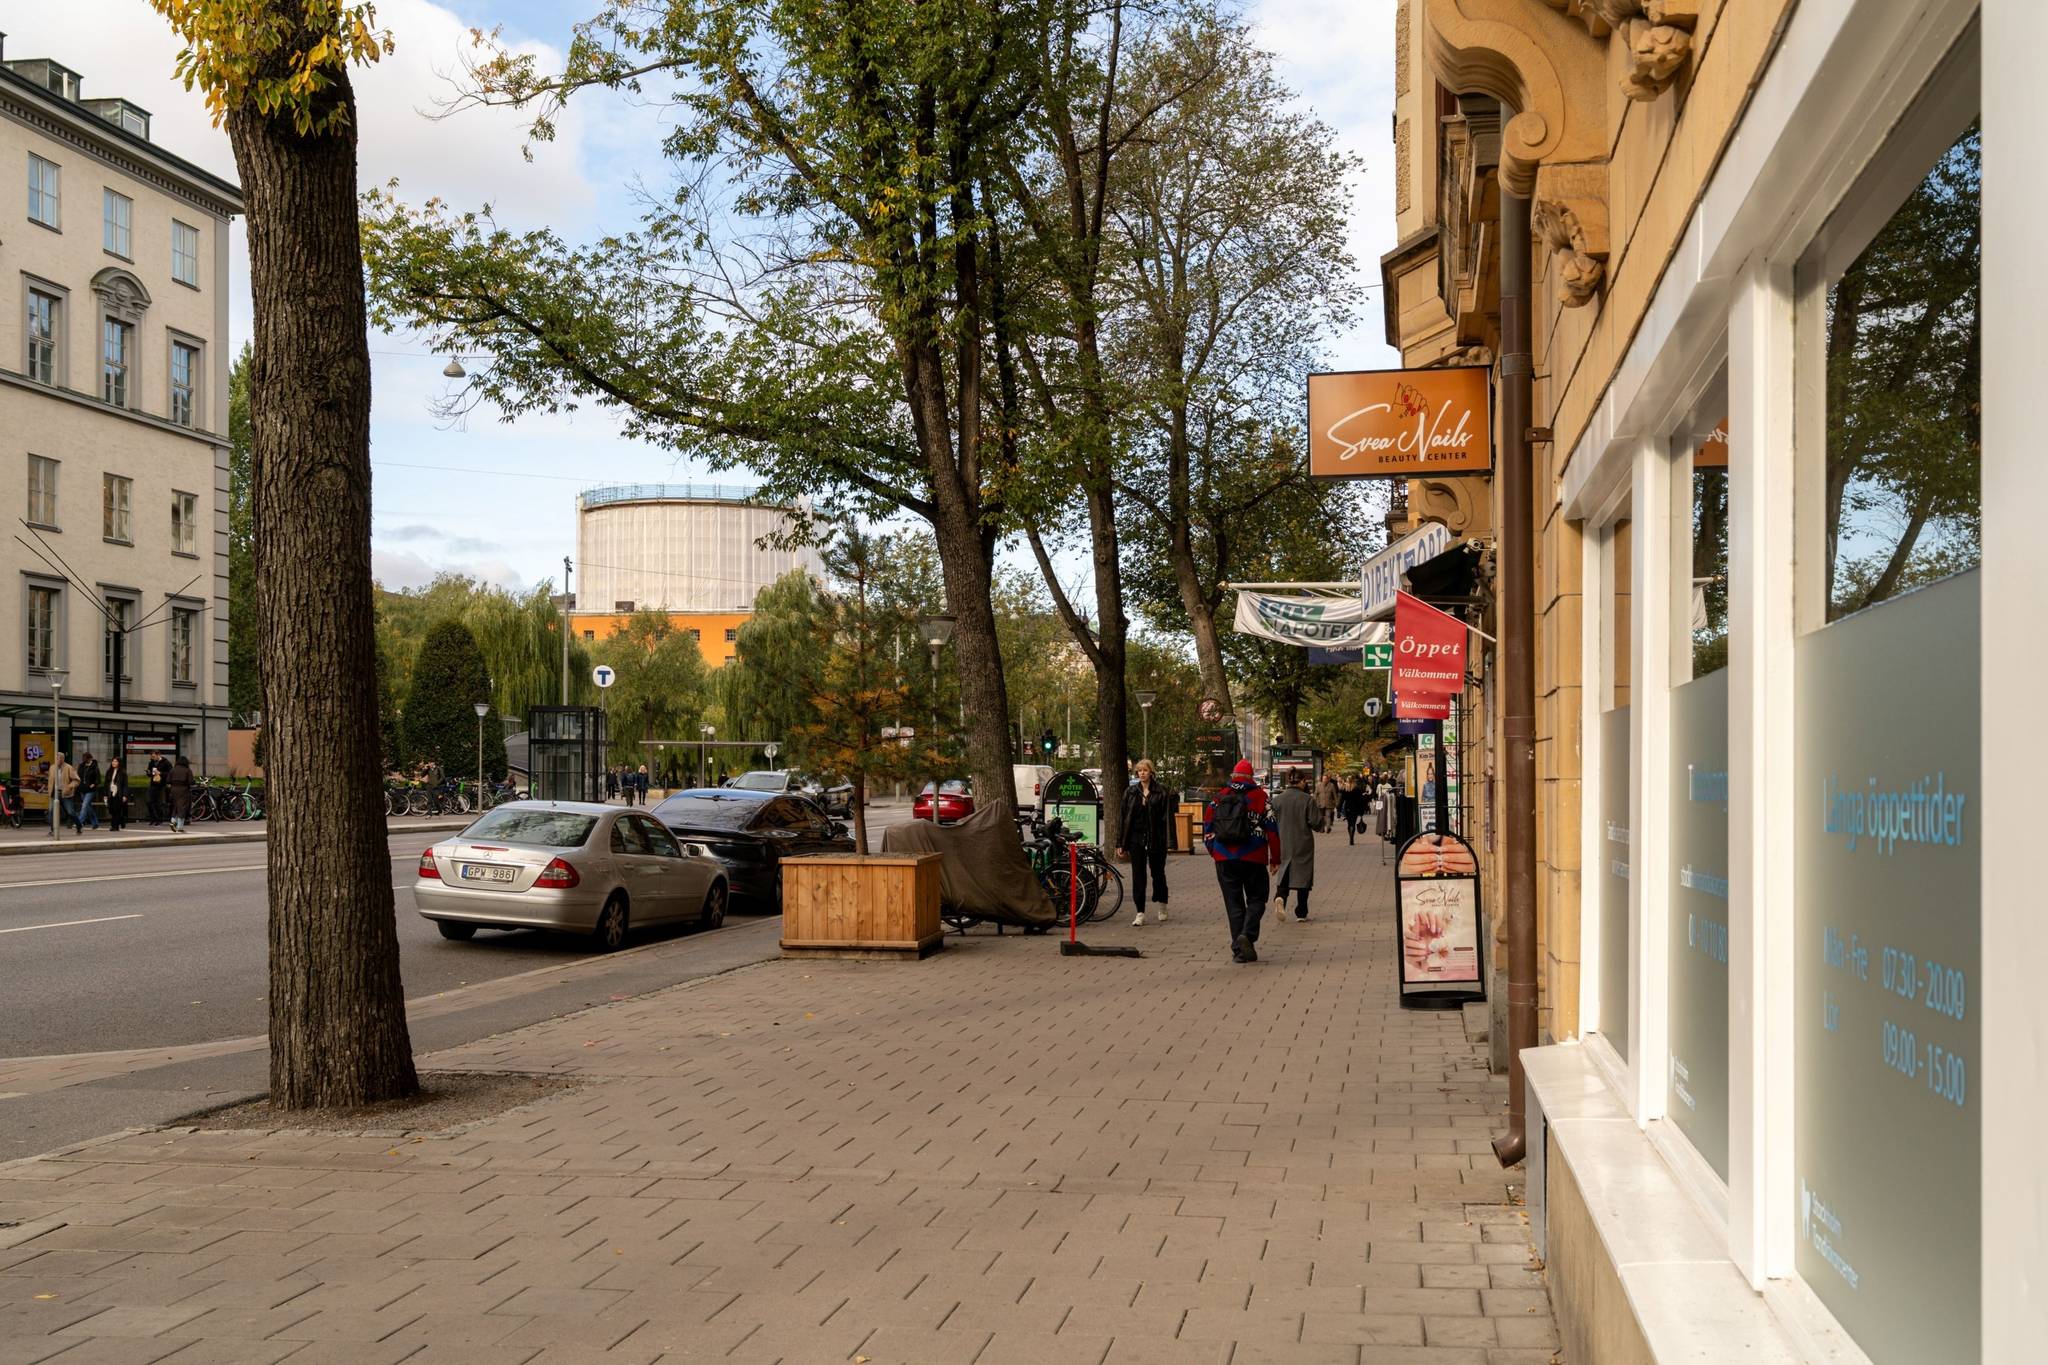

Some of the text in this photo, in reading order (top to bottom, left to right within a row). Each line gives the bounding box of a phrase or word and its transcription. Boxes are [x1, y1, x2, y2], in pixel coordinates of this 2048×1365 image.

[1327, 400, 1473, 462] Svea Nails
[1378, 452, 1467, 463] BEAUTY CENTER
[1400, 635, 1460, 658] Öppet
[596, 670, 611, 686] T
[1398, 668, 1459, 680] Välkommen
[1400, 700, 1447, 711] Välkommen
[1867, 770, 1966, 856] öppettider
[468, 866, 512, 880] GPW 986
[1882, 944, 1917, 1001] 07.30
[1925, 960, 1965, 1021] 20.00
[1882, 1020, 1917, 1079] 09.00
[1927, 1043, 1966, 1106] 15.00
